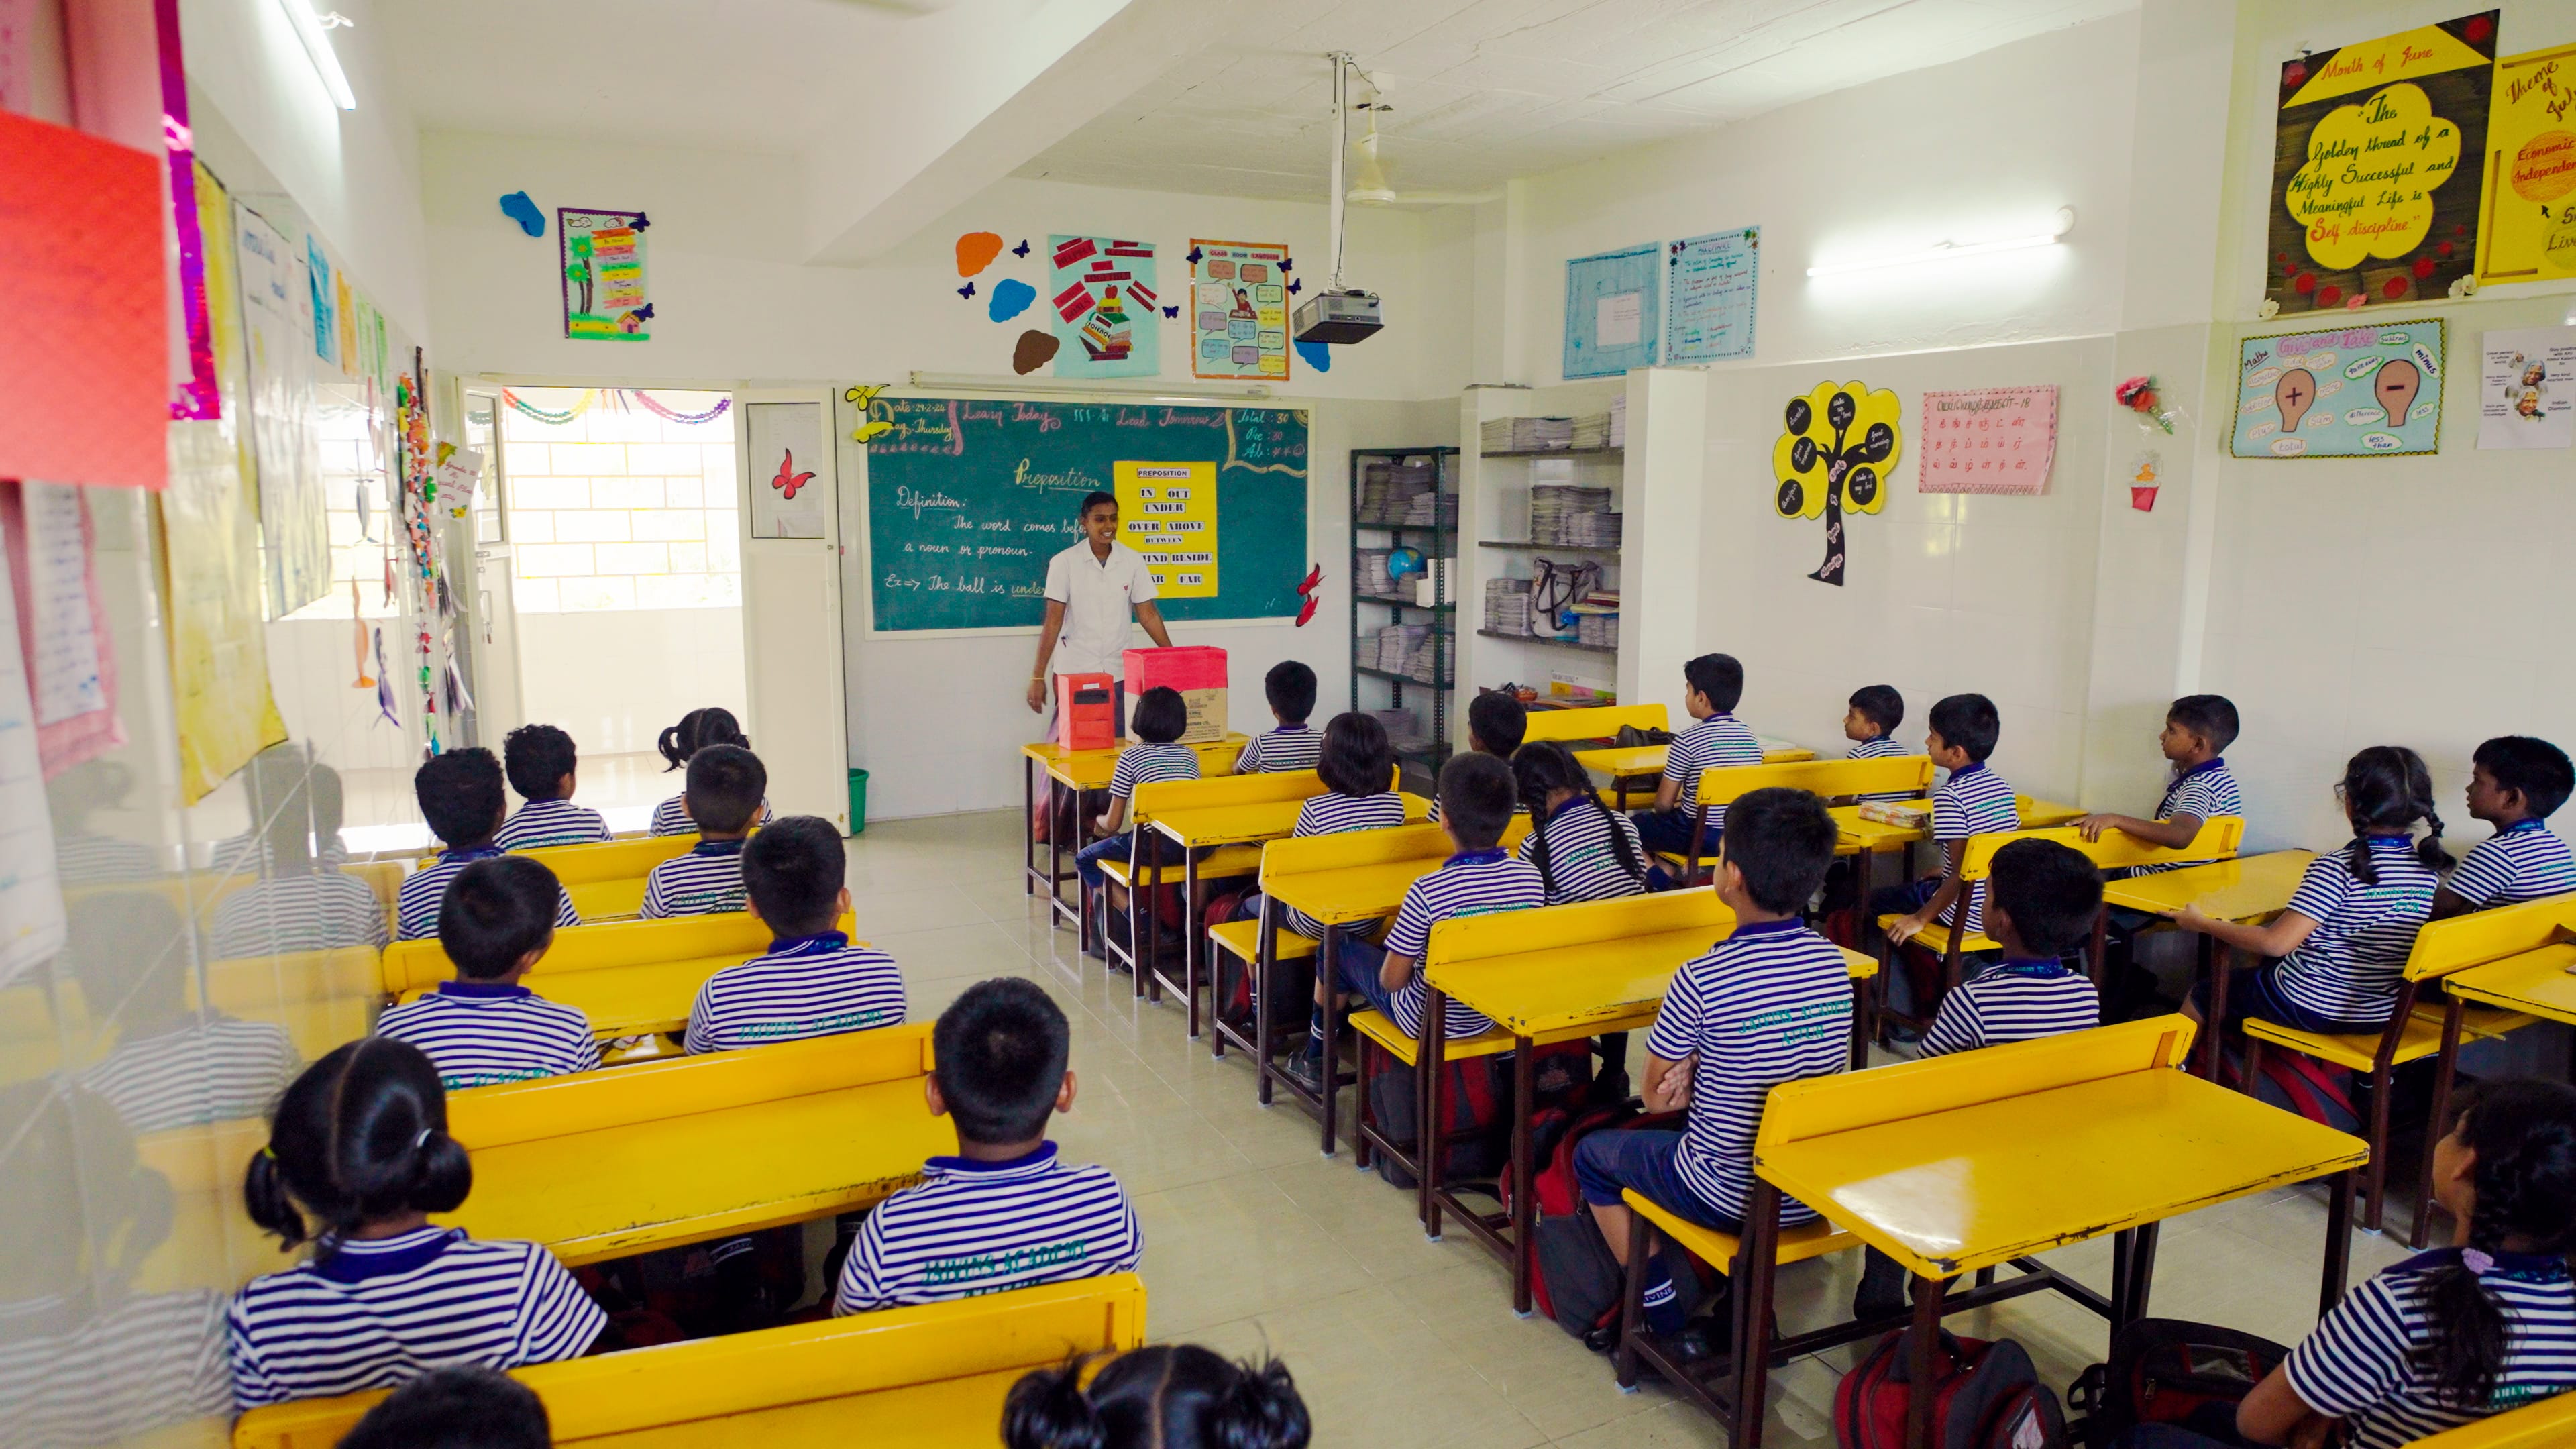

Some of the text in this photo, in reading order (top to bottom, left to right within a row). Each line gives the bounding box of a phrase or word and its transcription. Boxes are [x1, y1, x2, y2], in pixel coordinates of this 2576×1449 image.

[2320, 46, 2434, 80] Month of June
[2506, 60, 2559, 105] Theme
[2542, 77, 2557, 97] of
[2312, 138, 2359, 173] Golden
[2365, 129, 2406, 153] thread
[2413, 125, 2431, 150] of
[2288, 155, 2455, 199] Highly Successful and
[2296, 190, 2422, 218] Meaningful Life is
[2310, 217, 2341, 246] Self
[2279, 329, 2375, 354] Give and Take
[2415, 349, 2438, 374] minus
[963, 402, 1004, 427] Learn
[1011, 402, 1061, 433] Today
[1276, 412, 1289, 423] 30
[2349, 410, 2381, 419] difference
[2278, 439, 2304, 453] total
[2372, 441, 2393, 449] than
[1014, 458, 1101, 494] Preposition
[1141, 489, 1189, 498] IN OUT
[1144, 504, 1184, 512] UNDER
[953, 515, 973, 529] The
[981, 519, 1012, 532] word
[1023, 523, 1056, 533] comes
[1128, 522, 1203, 531] OVER ABOVE
[902, 543, 913, 553] a
[918, 544, 950, 553] noun
[957, 544, 972, 555] or
[1172, 553, 1212, 562] BESIDE
[928, 575, 950, 592] The
[956, 576, 985, 594] ball
[991, 581, 1006, 594] is
[1179, 575, 1201, 583] FAR
[738, 1009, 884, 1040] JAIVINS ACADEMY
[1738, 1008, 1794, 1034] JAIVINS
[1781, 1024, 1825, 1047] ATTUR
[922, 1238, 1089, 1285] JAIVINS ACADEMY
